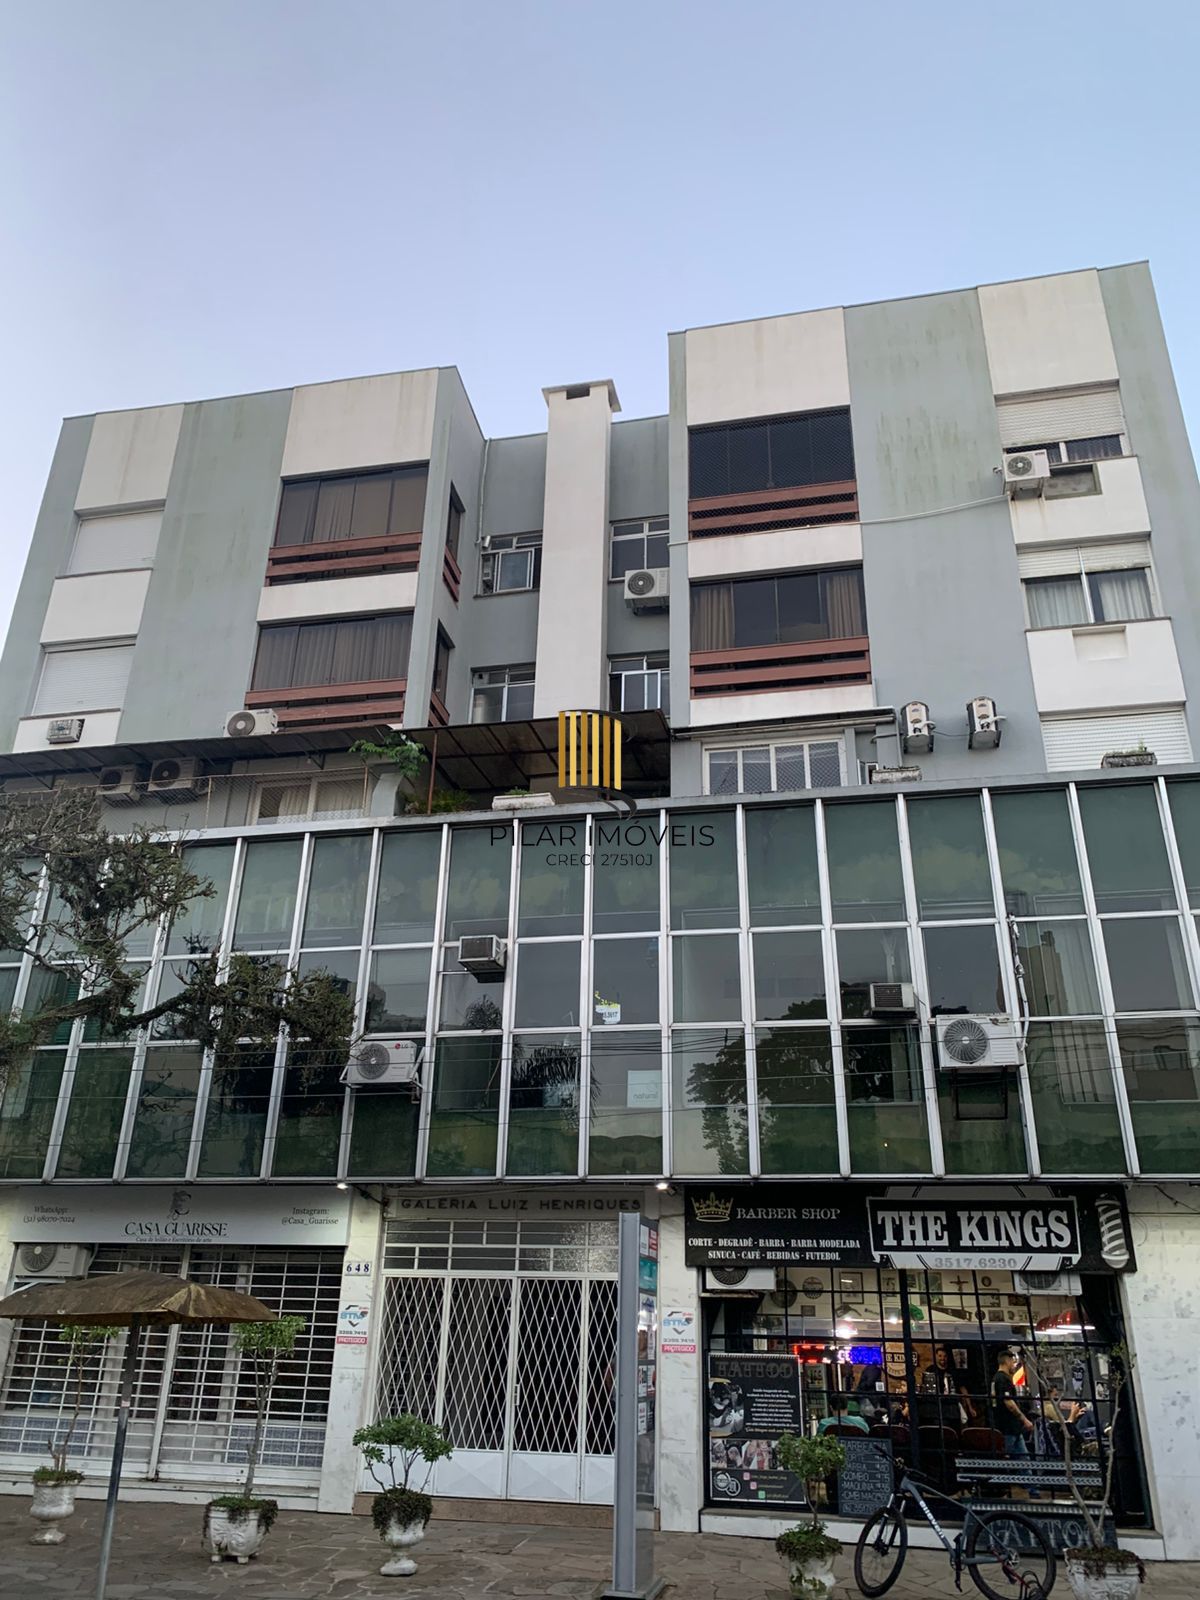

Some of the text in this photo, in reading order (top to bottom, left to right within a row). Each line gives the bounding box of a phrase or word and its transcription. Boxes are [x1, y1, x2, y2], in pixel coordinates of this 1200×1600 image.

[401, 1199, 641, 1211] GALERIA LUIZ HENRIQUES
[736, 1208, 840, 1219] BARBER SHOP
[124, 1222, 228, 1236] CASA GUARISSE
[877, 1209, 1072, 1248] THE KINGS
[688, 1236, 861, 1248] CORTE DEGRADÊ BARBA BARBA MODELADA
[708, 1249, 841, 1260] SINUCA CAFÉ BEBIDAS FUTEBOL
[934, 1257, 1017, 1269] 3517.6230
[715, 1361, 793, 1378] TATTOO
